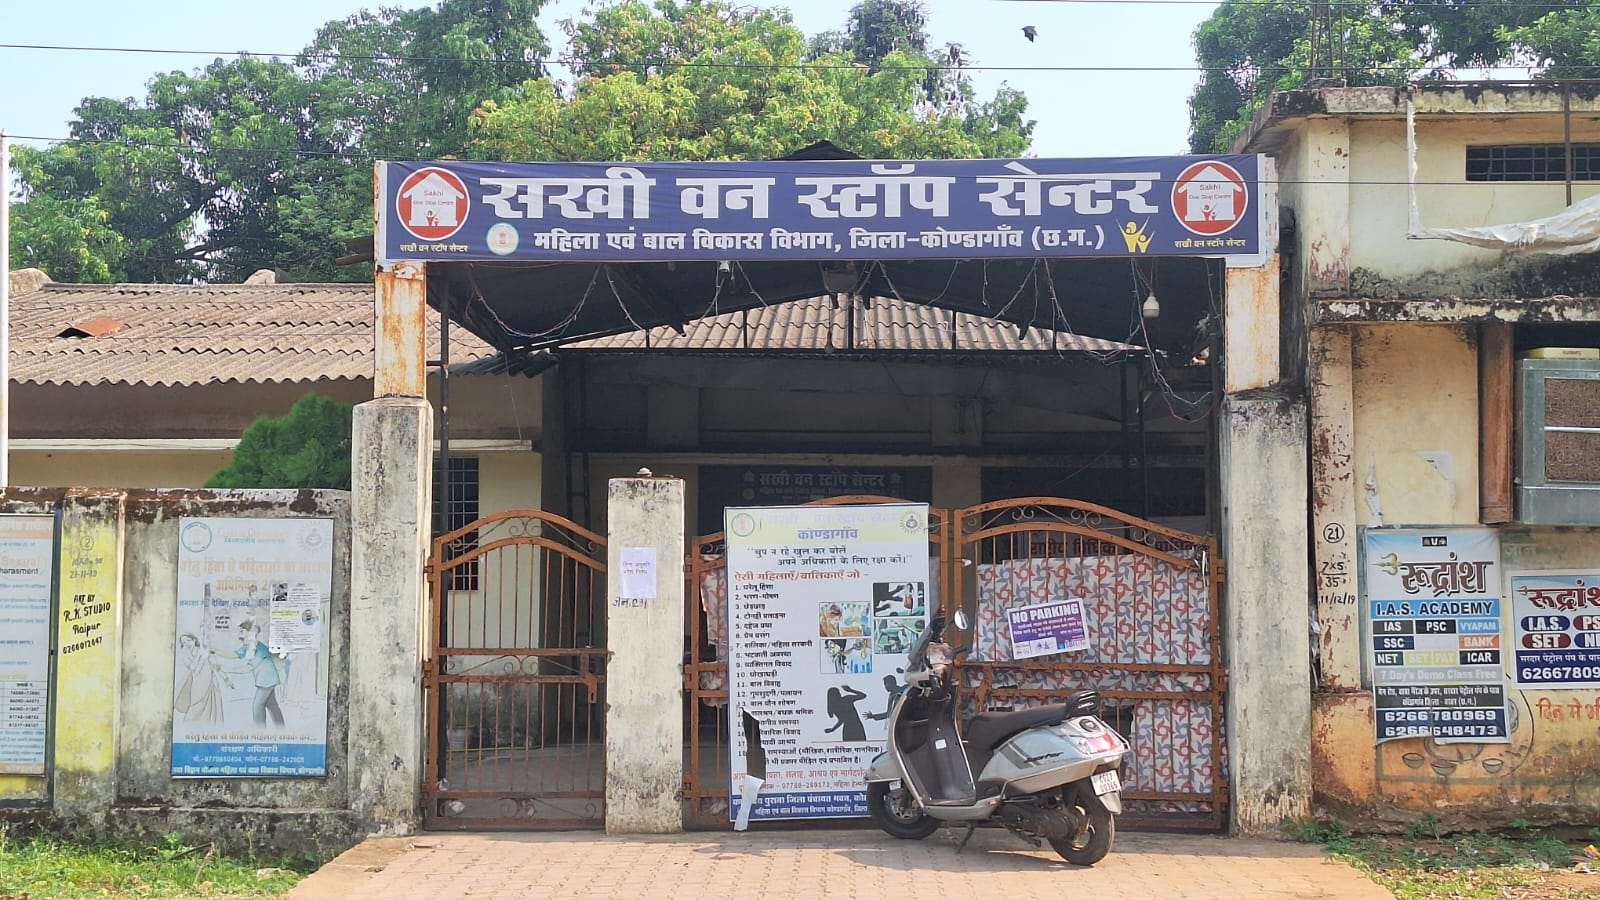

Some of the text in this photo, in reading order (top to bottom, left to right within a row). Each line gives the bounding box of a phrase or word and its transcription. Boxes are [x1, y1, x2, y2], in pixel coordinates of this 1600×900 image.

[479, 160, 1160, 220] सखी वन स्टॉप सेन्टर
[534, 228, 599, 251] महिला
[609, 226, 636, 252] एवं
[644, 231, 684, 251] बाल
[692, 227, 763, 251] विकास
[769, 226, 842, 253] विभाग,
[1031, 224, 1106, 252] (छ.ग.)
[758, 471, 790, 487] सखी
[1327, 527, 1339, 540] 21
[780, 546, 790, 556] रहे
[813, 548, 825, 556] कर
[778, 556, 797, 566] अपने
[839, 555, 849, 564] के
[852, 554, 869, 565] लिए
[872, 556, 887, 565] रक्षा
[734, 571, 754, 581] ऐसी
[847, 569, 860, 579] जो
[1325, 576, 1340, 587] 35
[1320, 592, 1355, 605] 11/12/19
[84, 602, 111, 617] STUDIO
[1012, 603, 1079, 624] NO PARKING
[1376, 601, 1493, 616] I.A.S. ACADEMY
[72, 623, 101, 637] Raipur
[1383, 621, 1496, 632] IAS PSC VYAPAM
[1528, 617, 1563, 631] I.A.S.
[1383, 637, 1493, 648] SSC BANK
[1531, 634, 1560, 648] SET
[1377, 653, 1398, 664] NET
[1467, 652, 1492, 663] ICAR
[1543, 653, 1563, 664] पेट्रोल
[1418, 670, 1444, 679] Demo
[1447, 670, 1474, 679] Class
[1475, 669, 1497, 679] Free
